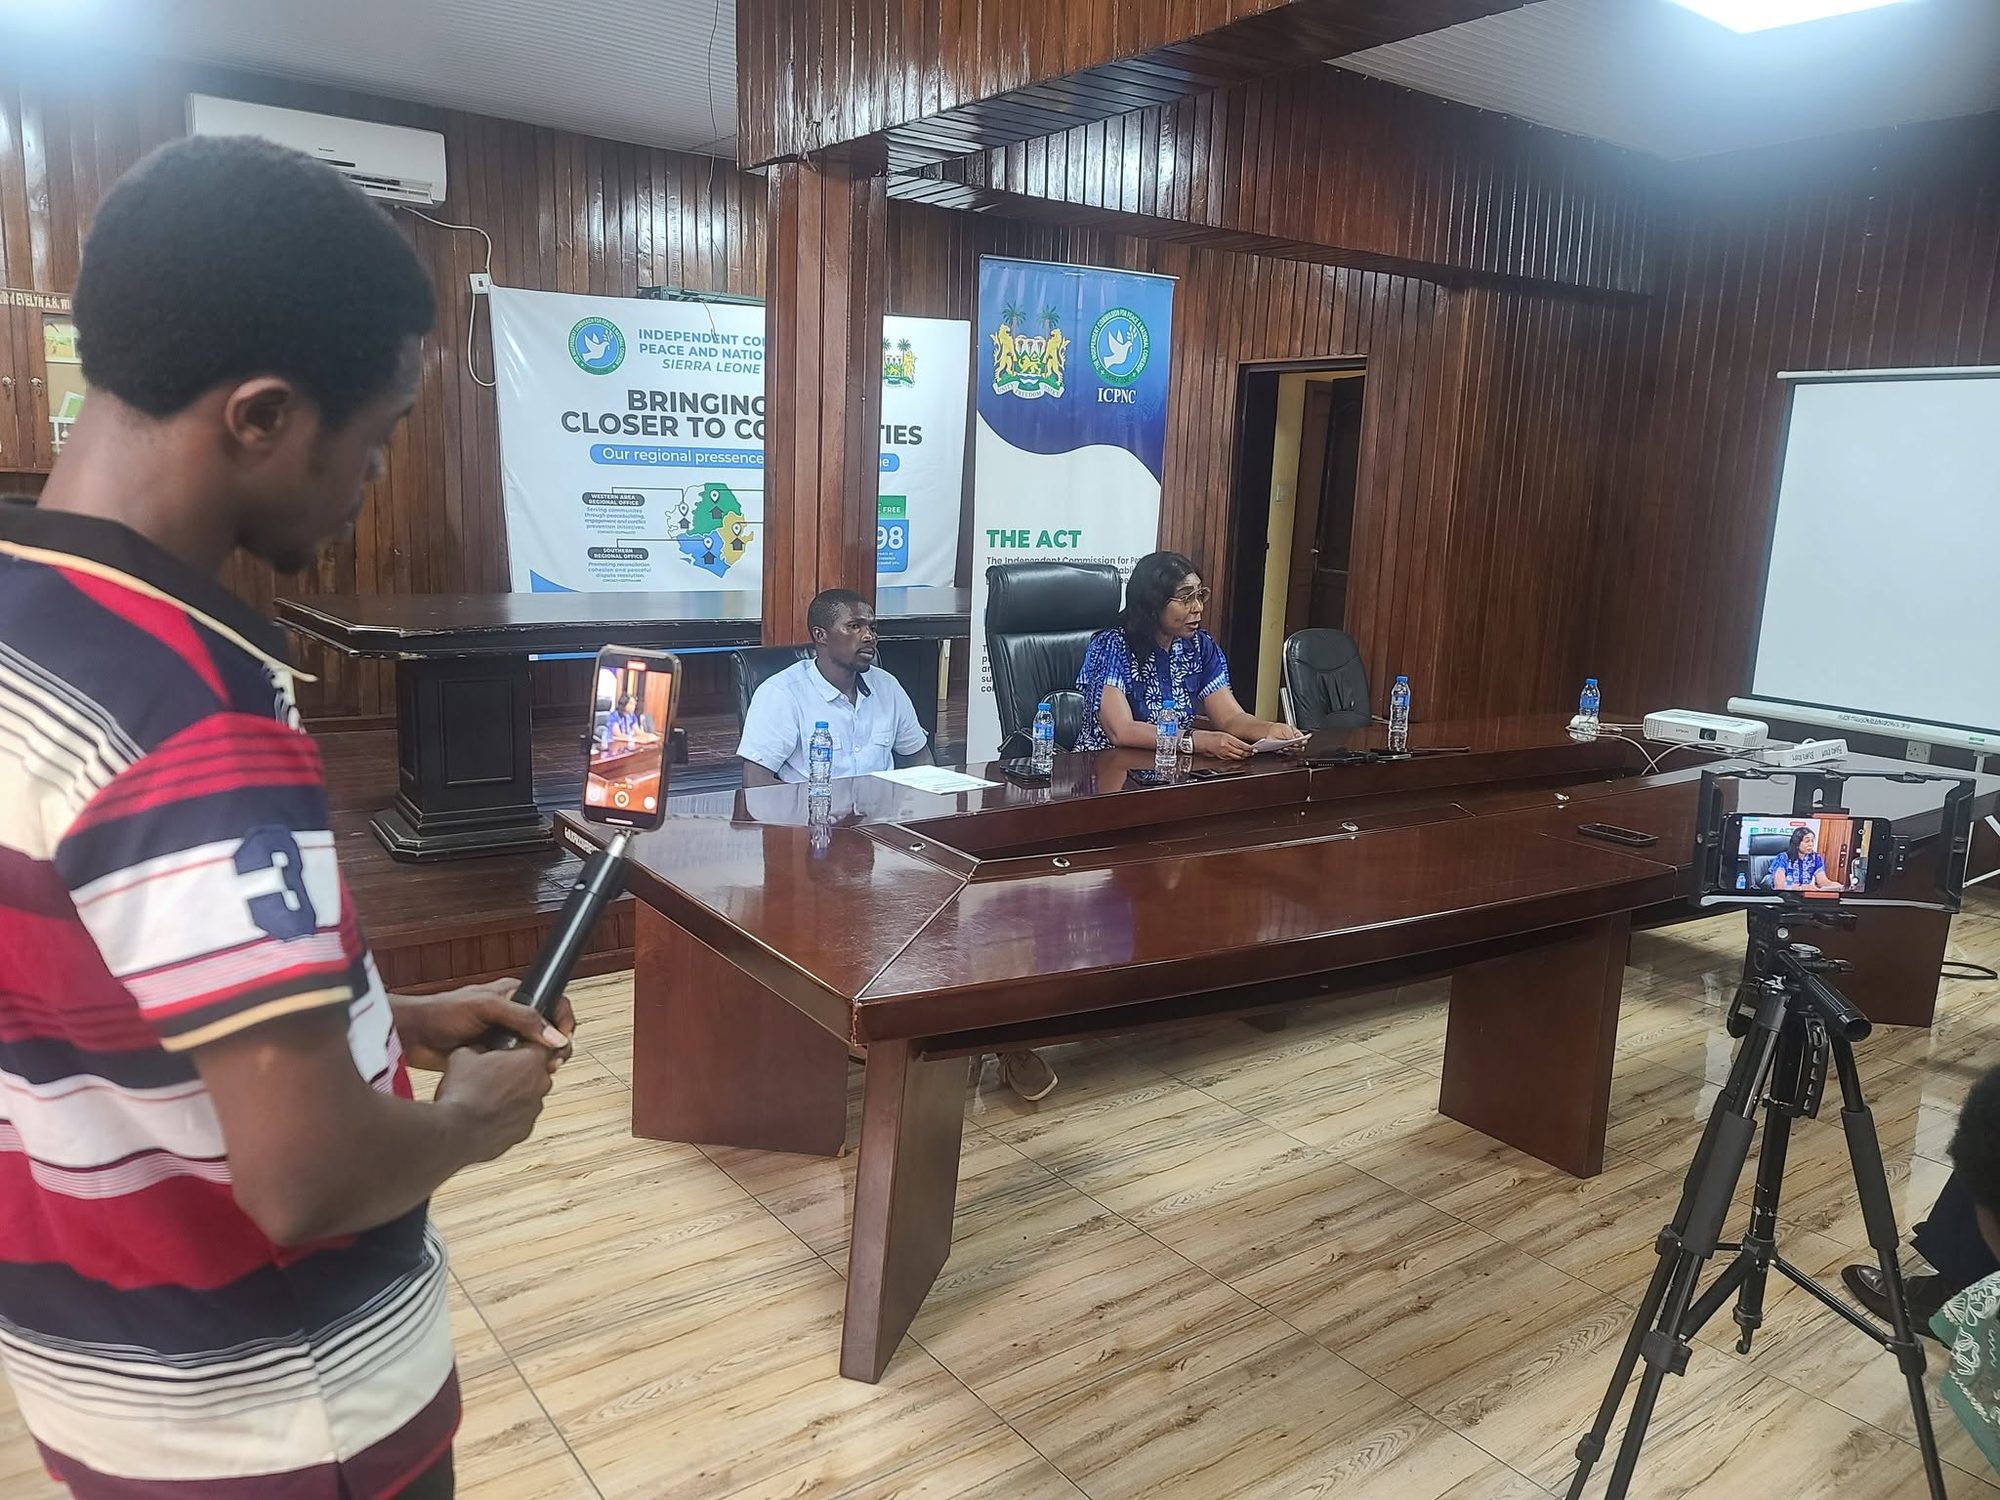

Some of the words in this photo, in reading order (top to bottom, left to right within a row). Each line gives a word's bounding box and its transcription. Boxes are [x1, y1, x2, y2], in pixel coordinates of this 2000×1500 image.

[60, 298, 70, 310] WI
[638, 328, 739, 345] INDEPENDENT
[639, 343, 684, 356] PEACE
[688, 346, 718, 358] AND
[722, 348, 765, 360] NATIO
[662, 358, 712, 372] SIERRA
[716, 362, 760, 374] LEONE
[1097, 388, 1136, 404] ICPNC
[561, 411, 679, 437] CLOSER
[686, 416, 726, 438] TO
[602, 448, 630, 460] Our
[634, 449, 692, 464] regional
[695, 451, 764, 465] pressence
[877, 526, 904, 550] 98
[986, 529, 1030, 548] THE
[1036, 529, 1082, 548] ACT
[1062, 556, 1116, 564] Commission
[1118, 556, 1129, 564] for
[234, 824, 317, 942] 3
